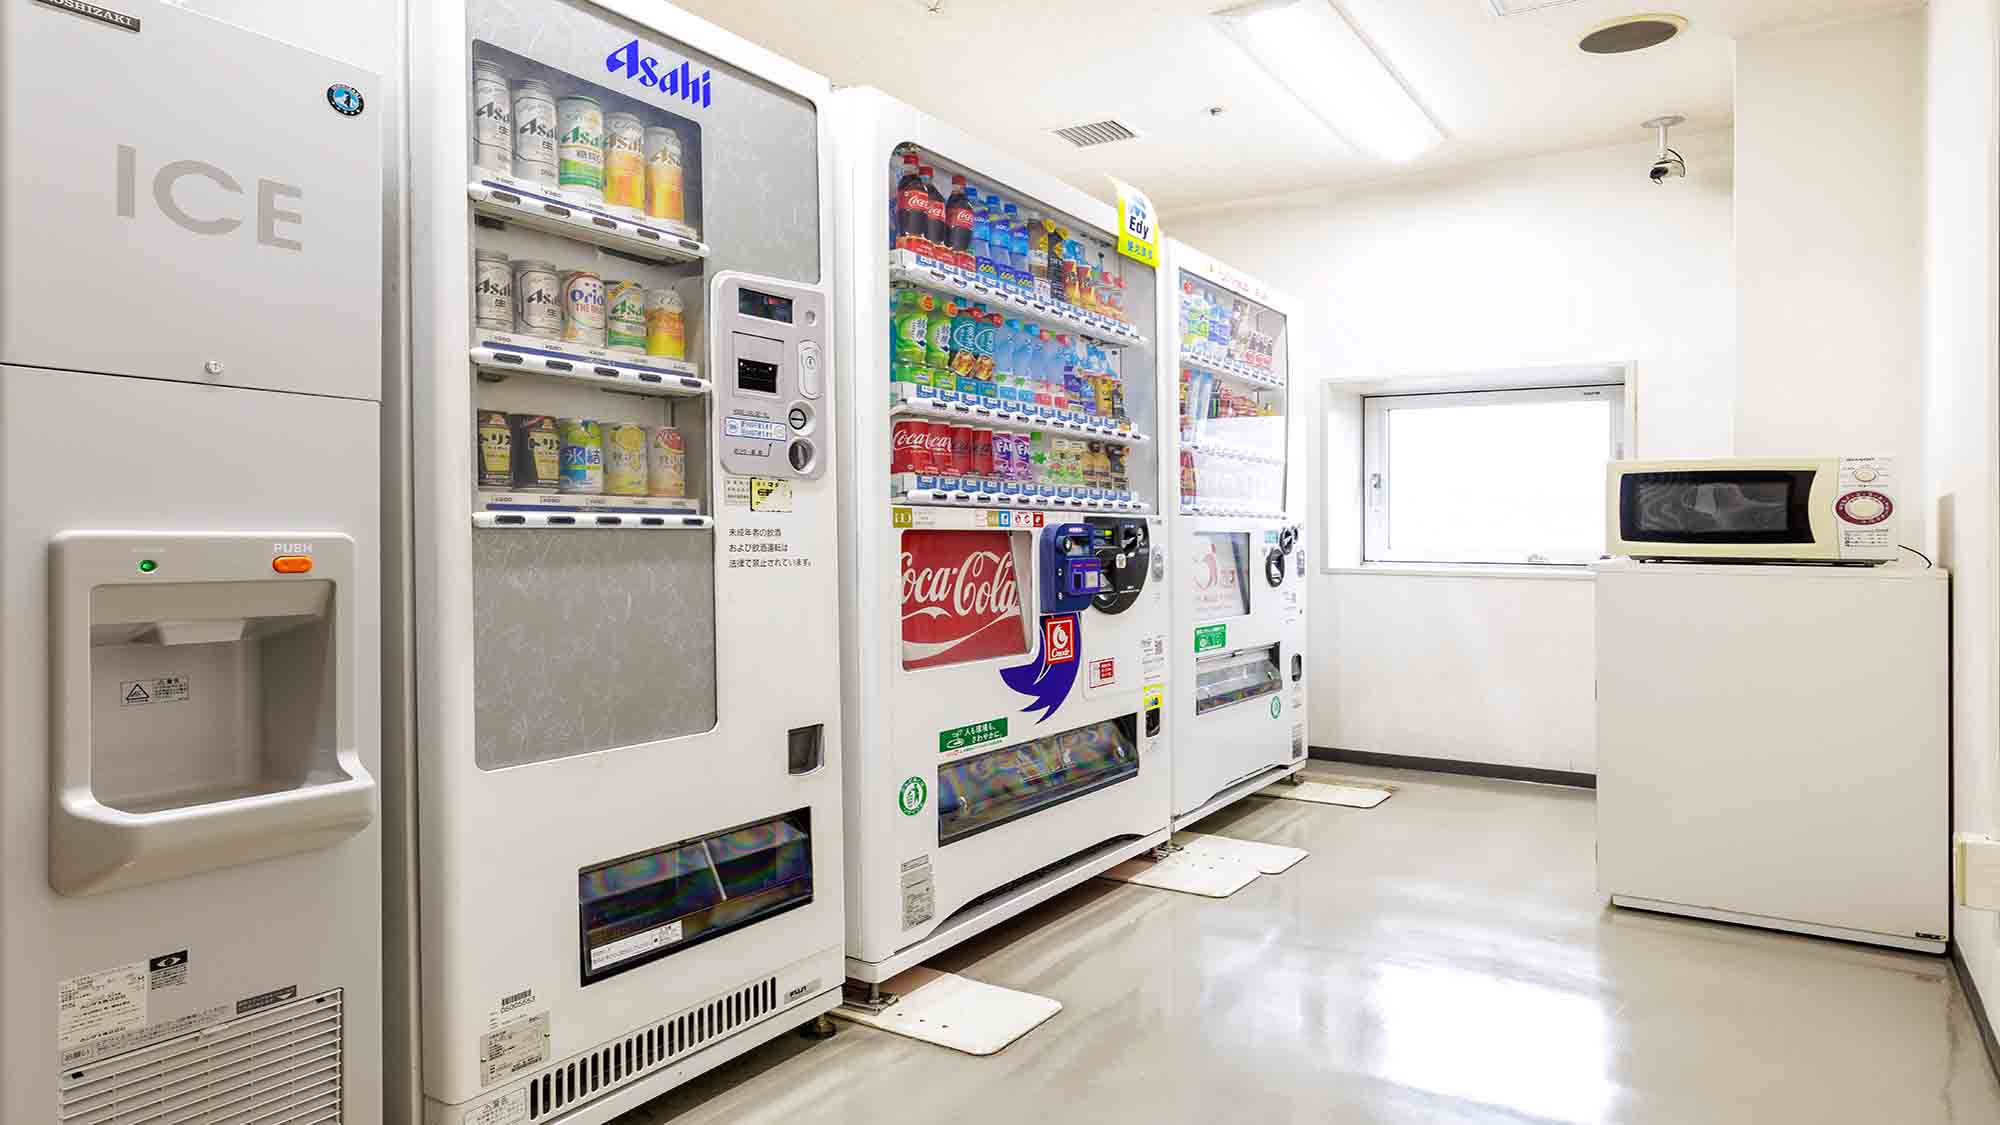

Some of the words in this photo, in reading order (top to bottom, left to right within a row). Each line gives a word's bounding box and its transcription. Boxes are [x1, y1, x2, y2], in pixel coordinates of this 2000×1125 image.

[606, 39, 711, 109] Asahi
[116, 144, 303, 252] ICE
[1129, 215, 1150, 240] Edy
[728, 528, 782, 537] 未成年者の飲酒
[273, 543, 313, 553] PUSH
